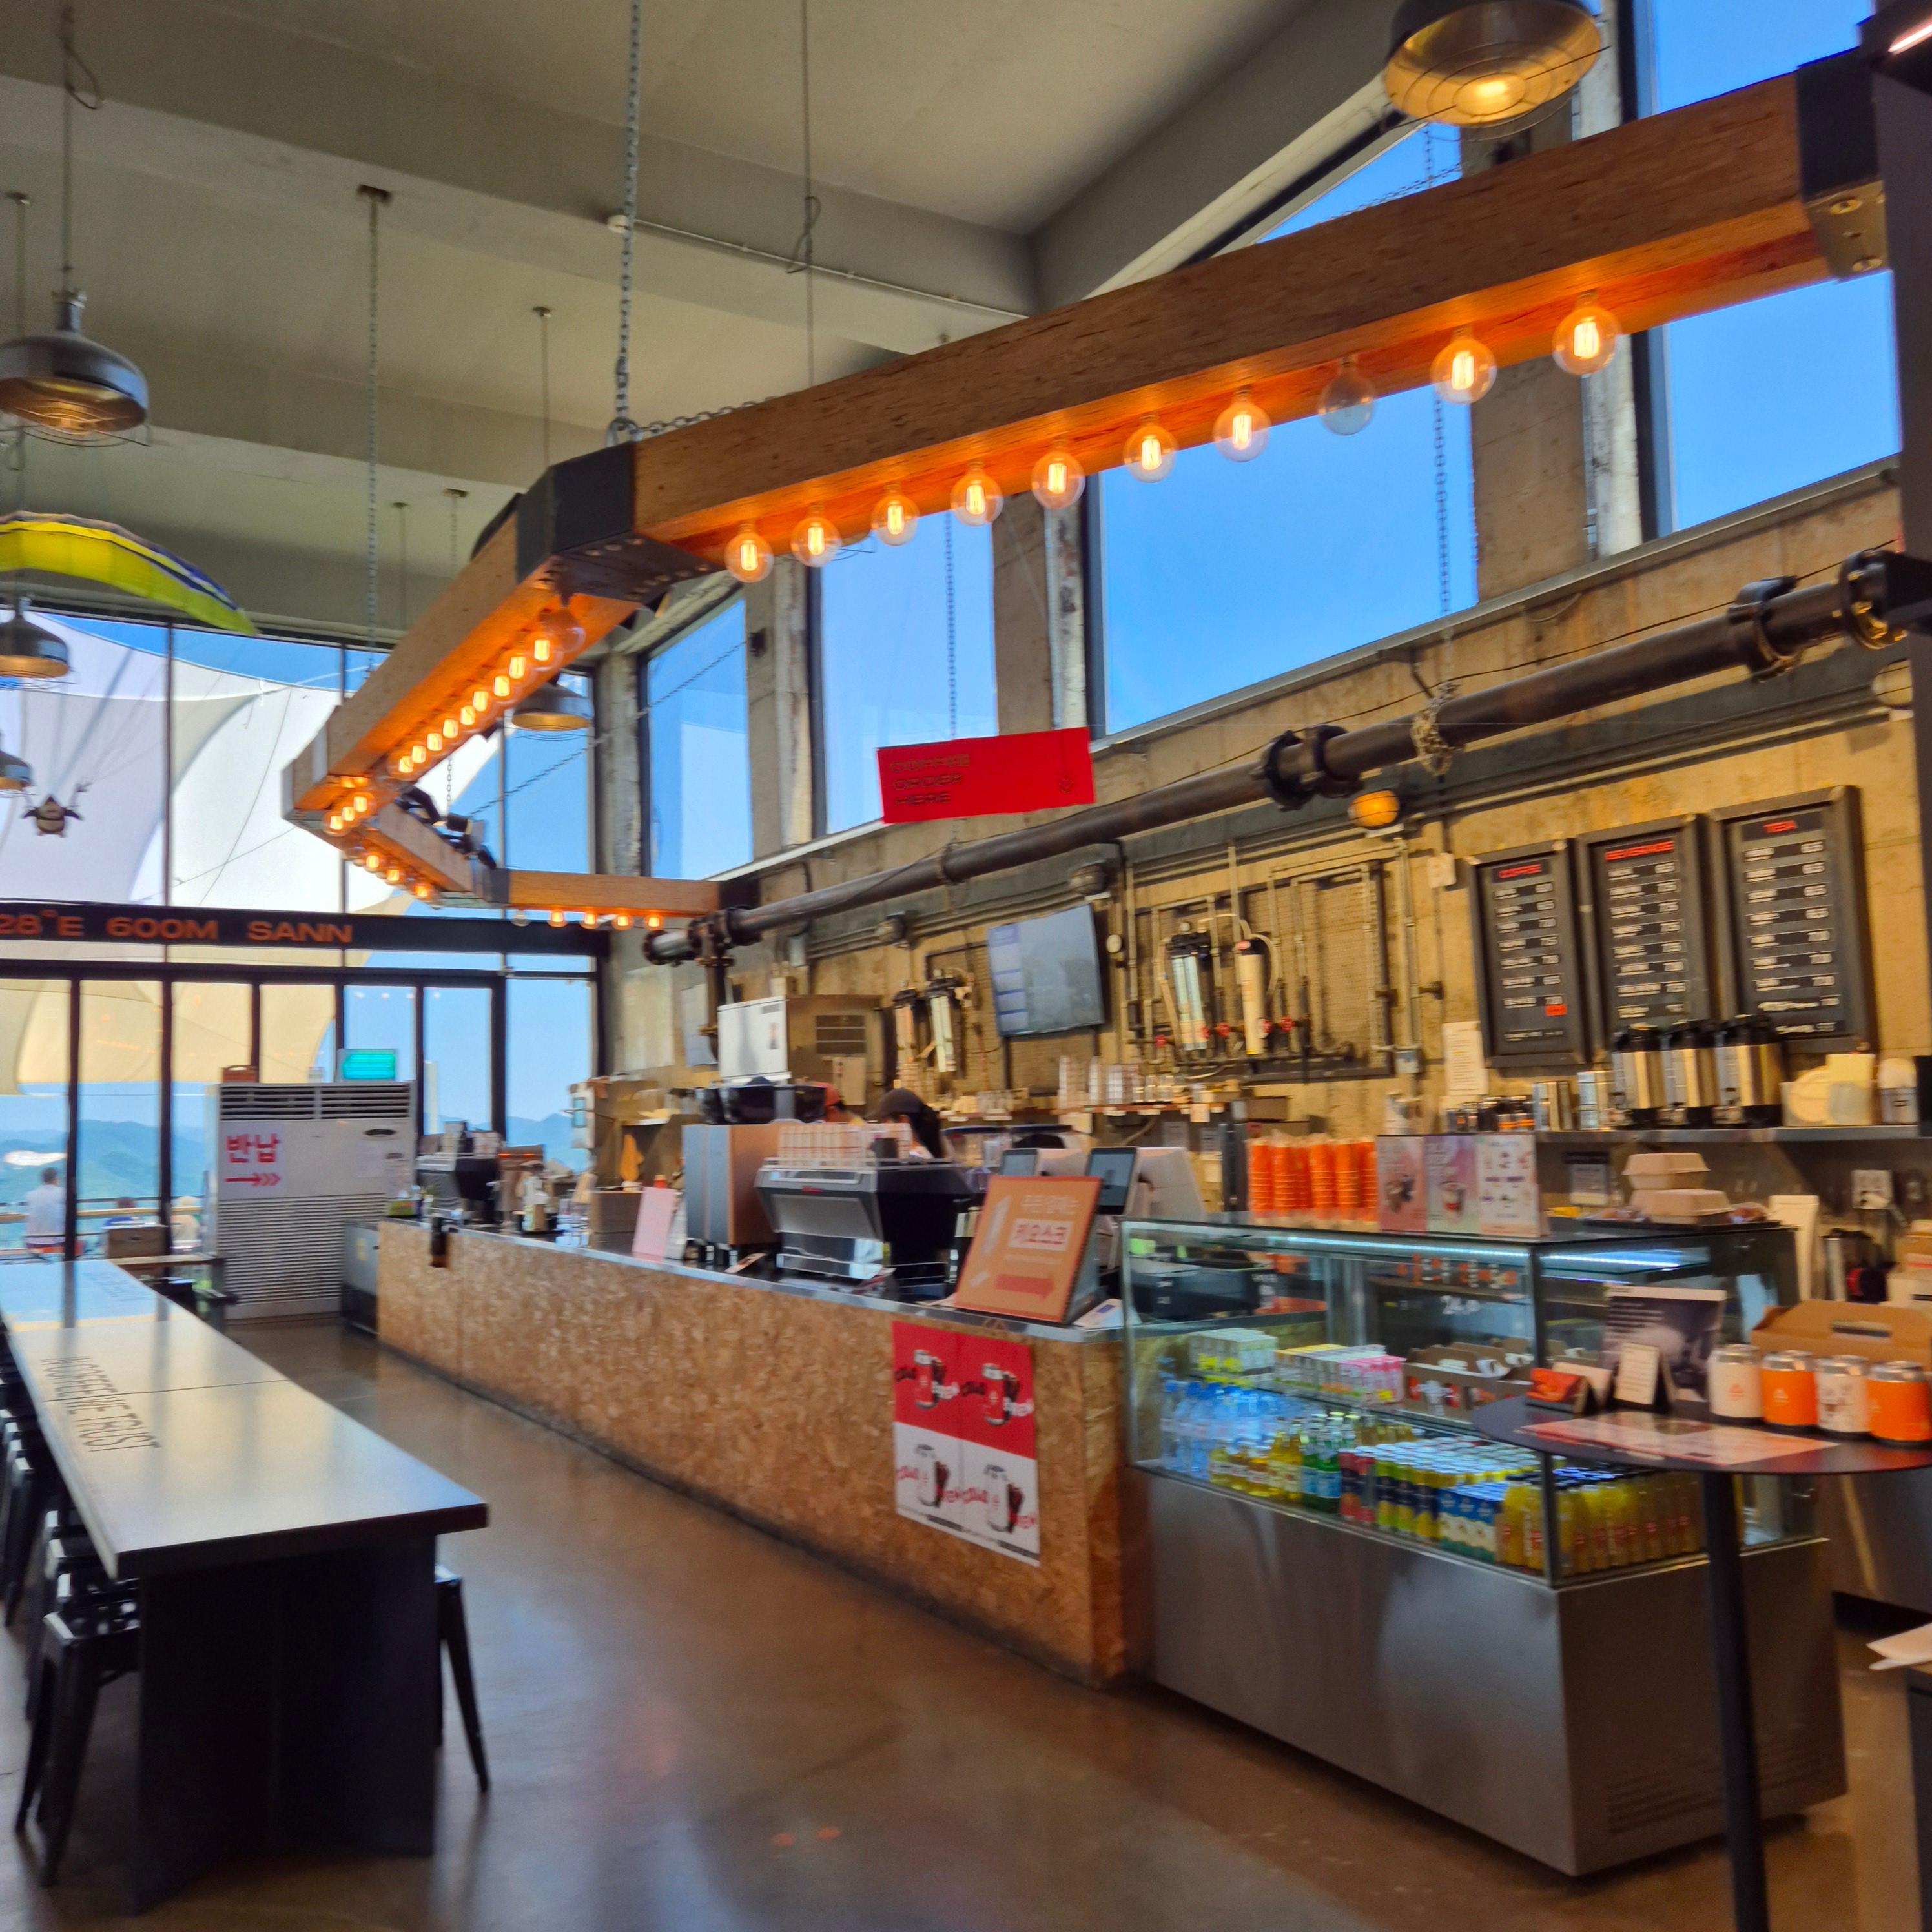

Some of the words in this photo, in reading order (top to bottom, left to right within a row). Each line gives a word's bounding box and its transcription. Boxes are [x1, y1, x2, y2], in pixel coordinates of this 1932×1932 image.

[891, 754, 971, 772] COFFEE
[894, 773, 962, 790] ORDER
[896, 792, 951, 806] HERE
[105, 916, 219, 940] 600M
[246, 921, 353, 943] SANN
[225, 1133, 282, 1164] 반납
[72, 1412, 161, 1452] TRUST
